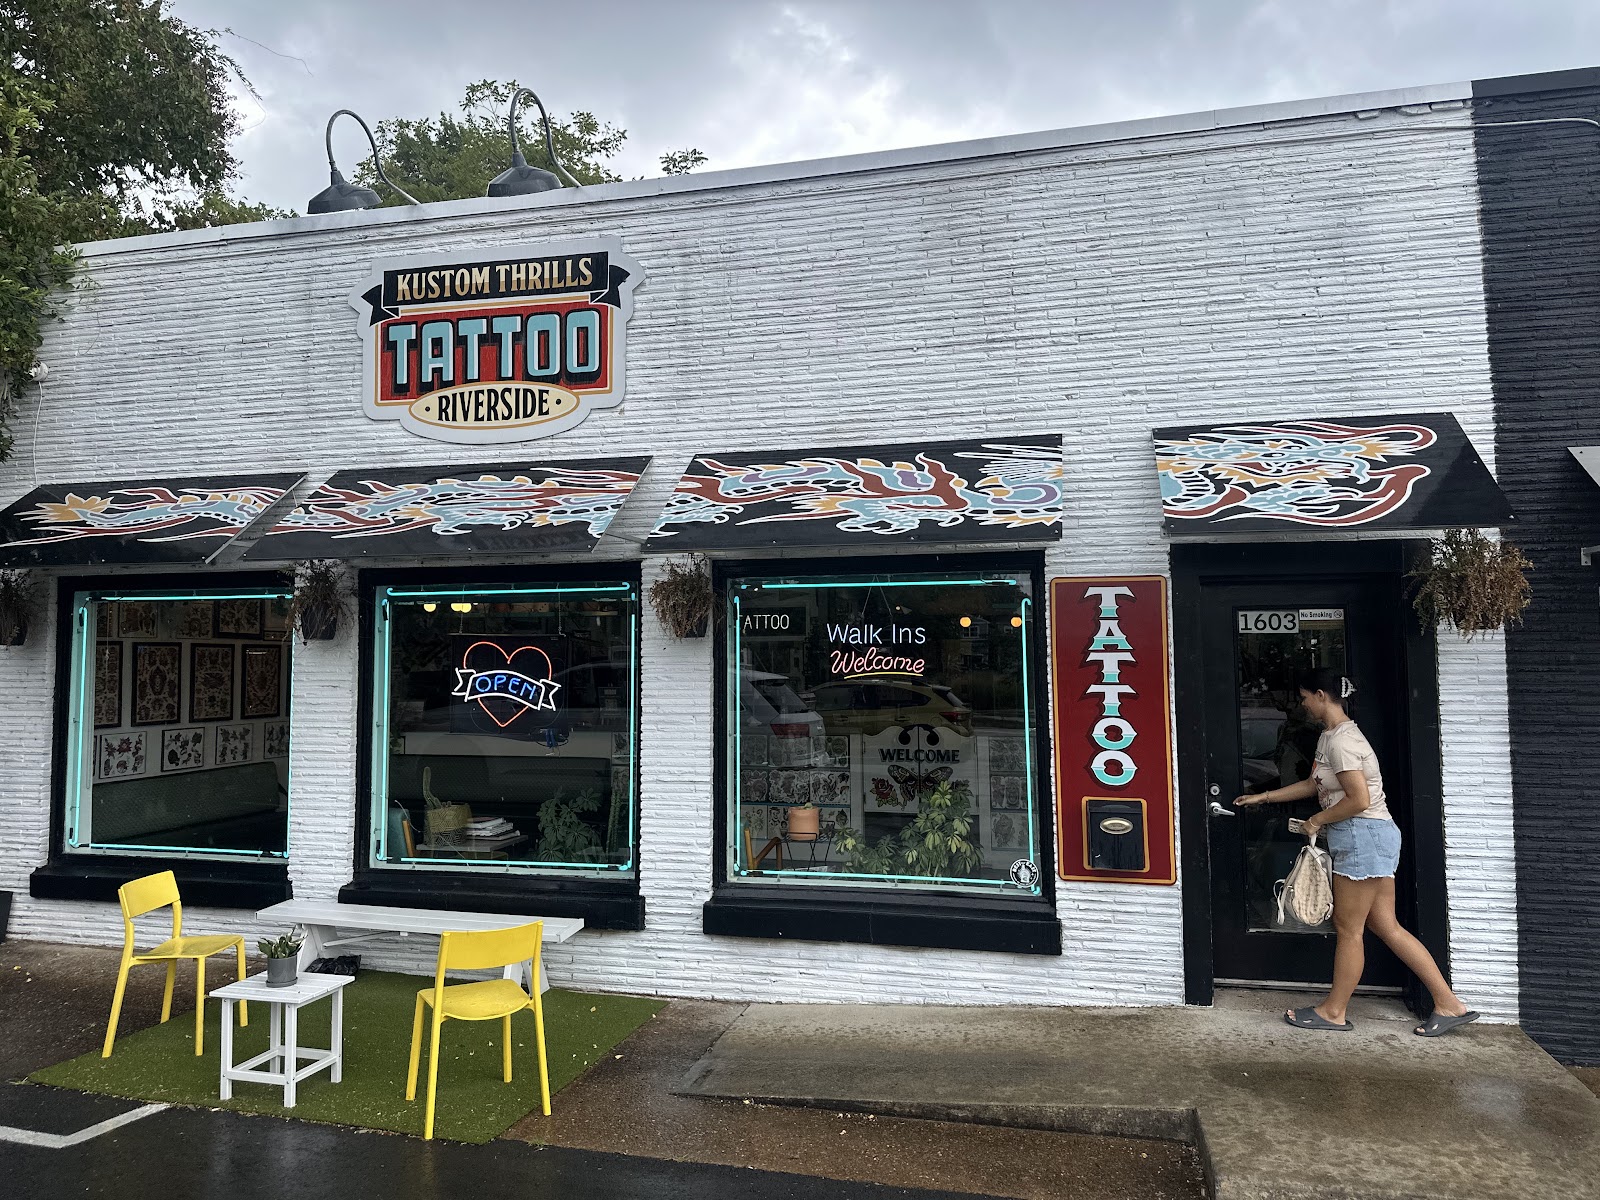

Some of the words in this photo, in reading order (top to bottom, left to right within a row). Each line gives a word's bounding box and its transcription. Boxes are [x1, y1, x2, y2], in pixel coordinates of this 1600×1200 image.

[397, 265, 491, 301] KUSTOM
[496, 257, 592, 292] THRILLS
[387, 309, 601, 386] TATTOO
[437, 387, 550, 422] RIVERSIDE
[826, 623, 883, 645] Walk
[892, 623, 926, 645] Ins
[1240, 612, 1297, 631] 1603
[830, 646, 925, 673] Welcome
[475, 675, 536, 700] OPEN
[1083, 586, 1139, 786] TATTOO
[878, 748, 960, 764] WELCOME
